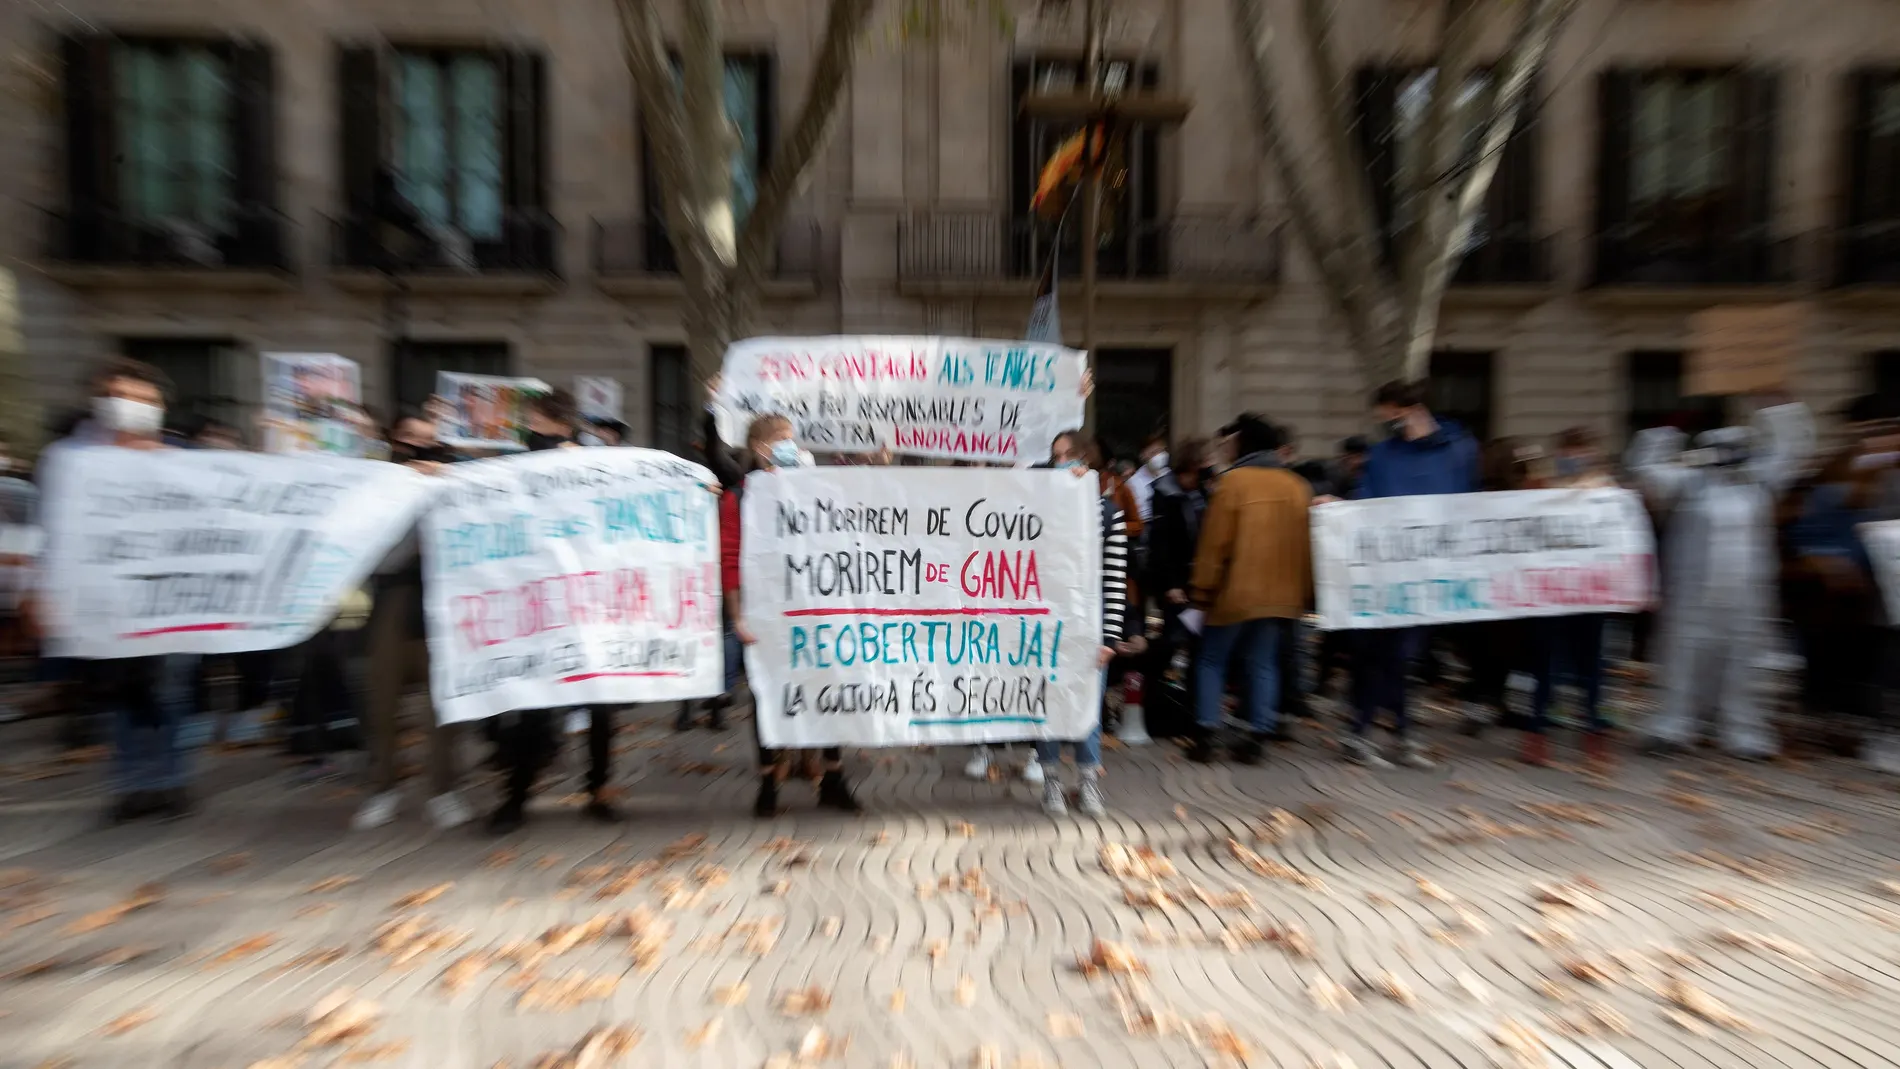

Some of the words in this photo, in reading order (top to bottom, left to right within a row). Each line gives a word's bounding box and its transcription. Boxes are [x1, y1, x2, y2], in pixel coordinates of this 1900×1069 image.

[818, 348, 927, 383] CONTAGIS
[938, 350, 975, 387] ALS
[858, 393, 986, 428] RESPONSABLES
[1000, 399, 1028, 432] DE
[927, 506, 951, 537] DE
[784, 542, 922, 601] MORIREM
[926, 562, 951, 584] DE
[960, 549, 1042, 601] GANA
[790, 620, 1001, 670] REOBERTURA
[1008, 615, 1063, 683] JA!
[782, 681, 808, 719] LA
[818, 677, 900, 717] CULTURA
[910, 671, 937, 717] ÉS
[946, 675, 1048, 717] SEGURA
